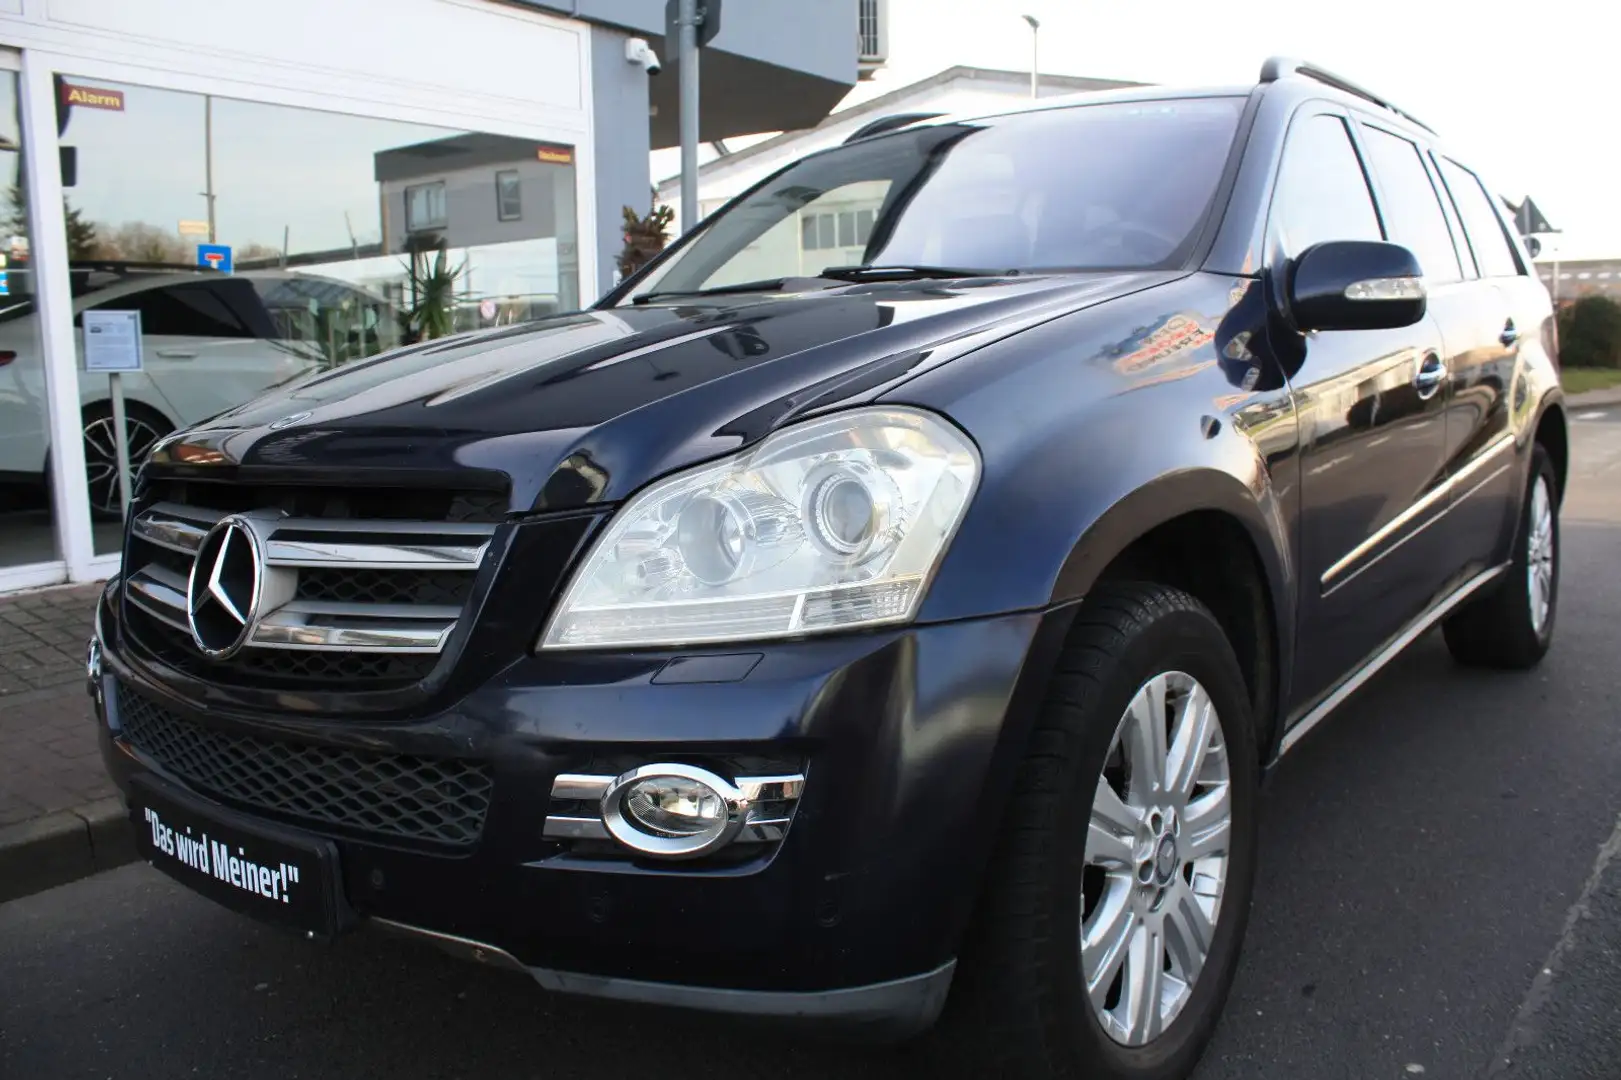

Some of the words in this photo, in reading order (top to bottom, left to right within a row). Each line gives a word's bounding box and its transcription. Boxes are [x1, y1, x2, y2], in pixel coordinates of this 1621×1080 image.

[68, 88, 121, 107] Alarm
[144, 807, 174, 856] "Das
[175, 826, 209, 874] wird
[211, 840, 299, 903] Meiner!"
